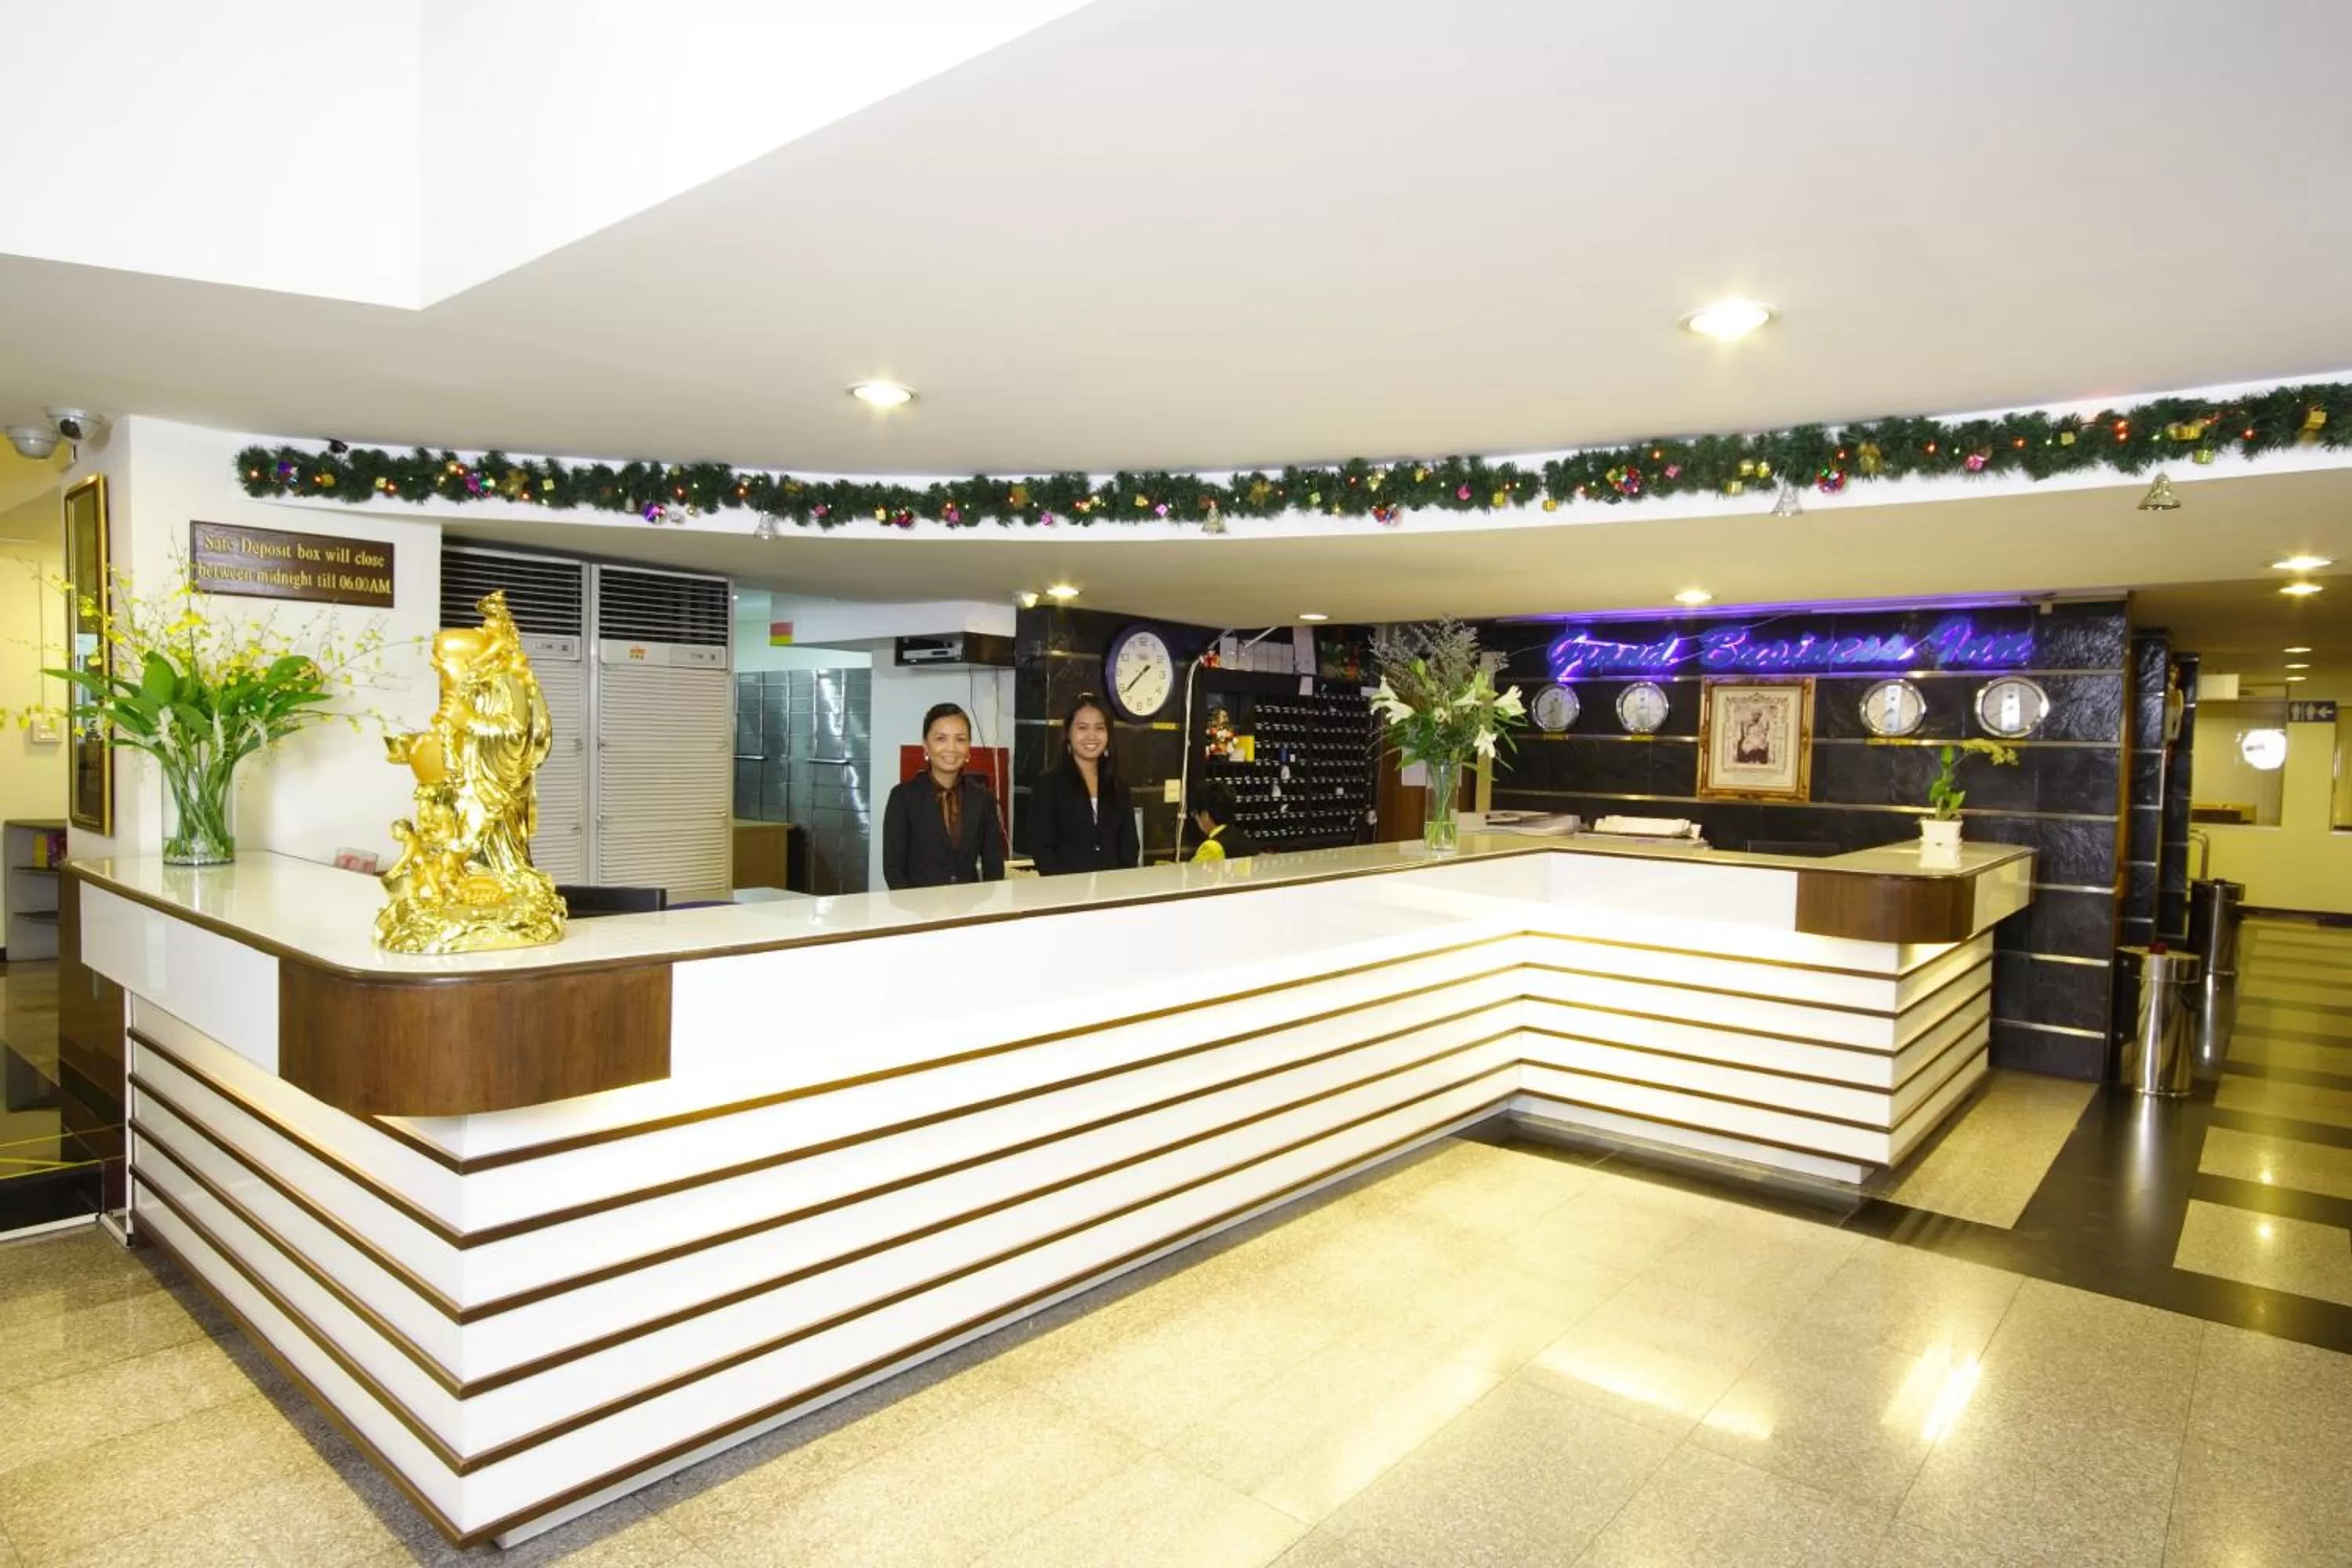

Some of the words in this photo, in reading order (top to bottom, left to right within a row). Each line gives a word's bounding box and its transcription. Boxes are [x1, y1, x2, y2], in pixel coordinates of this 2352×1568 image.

[241, 539, 291, 559] Deposit
[297, 543, 320, 561] box
[325, 546, 350, 564] will
[354, 551, 385, 568] close
[198, 562, 252, 582] between
[256, 569, 312, 590] midnight
[318, 573, 336, 590] till
